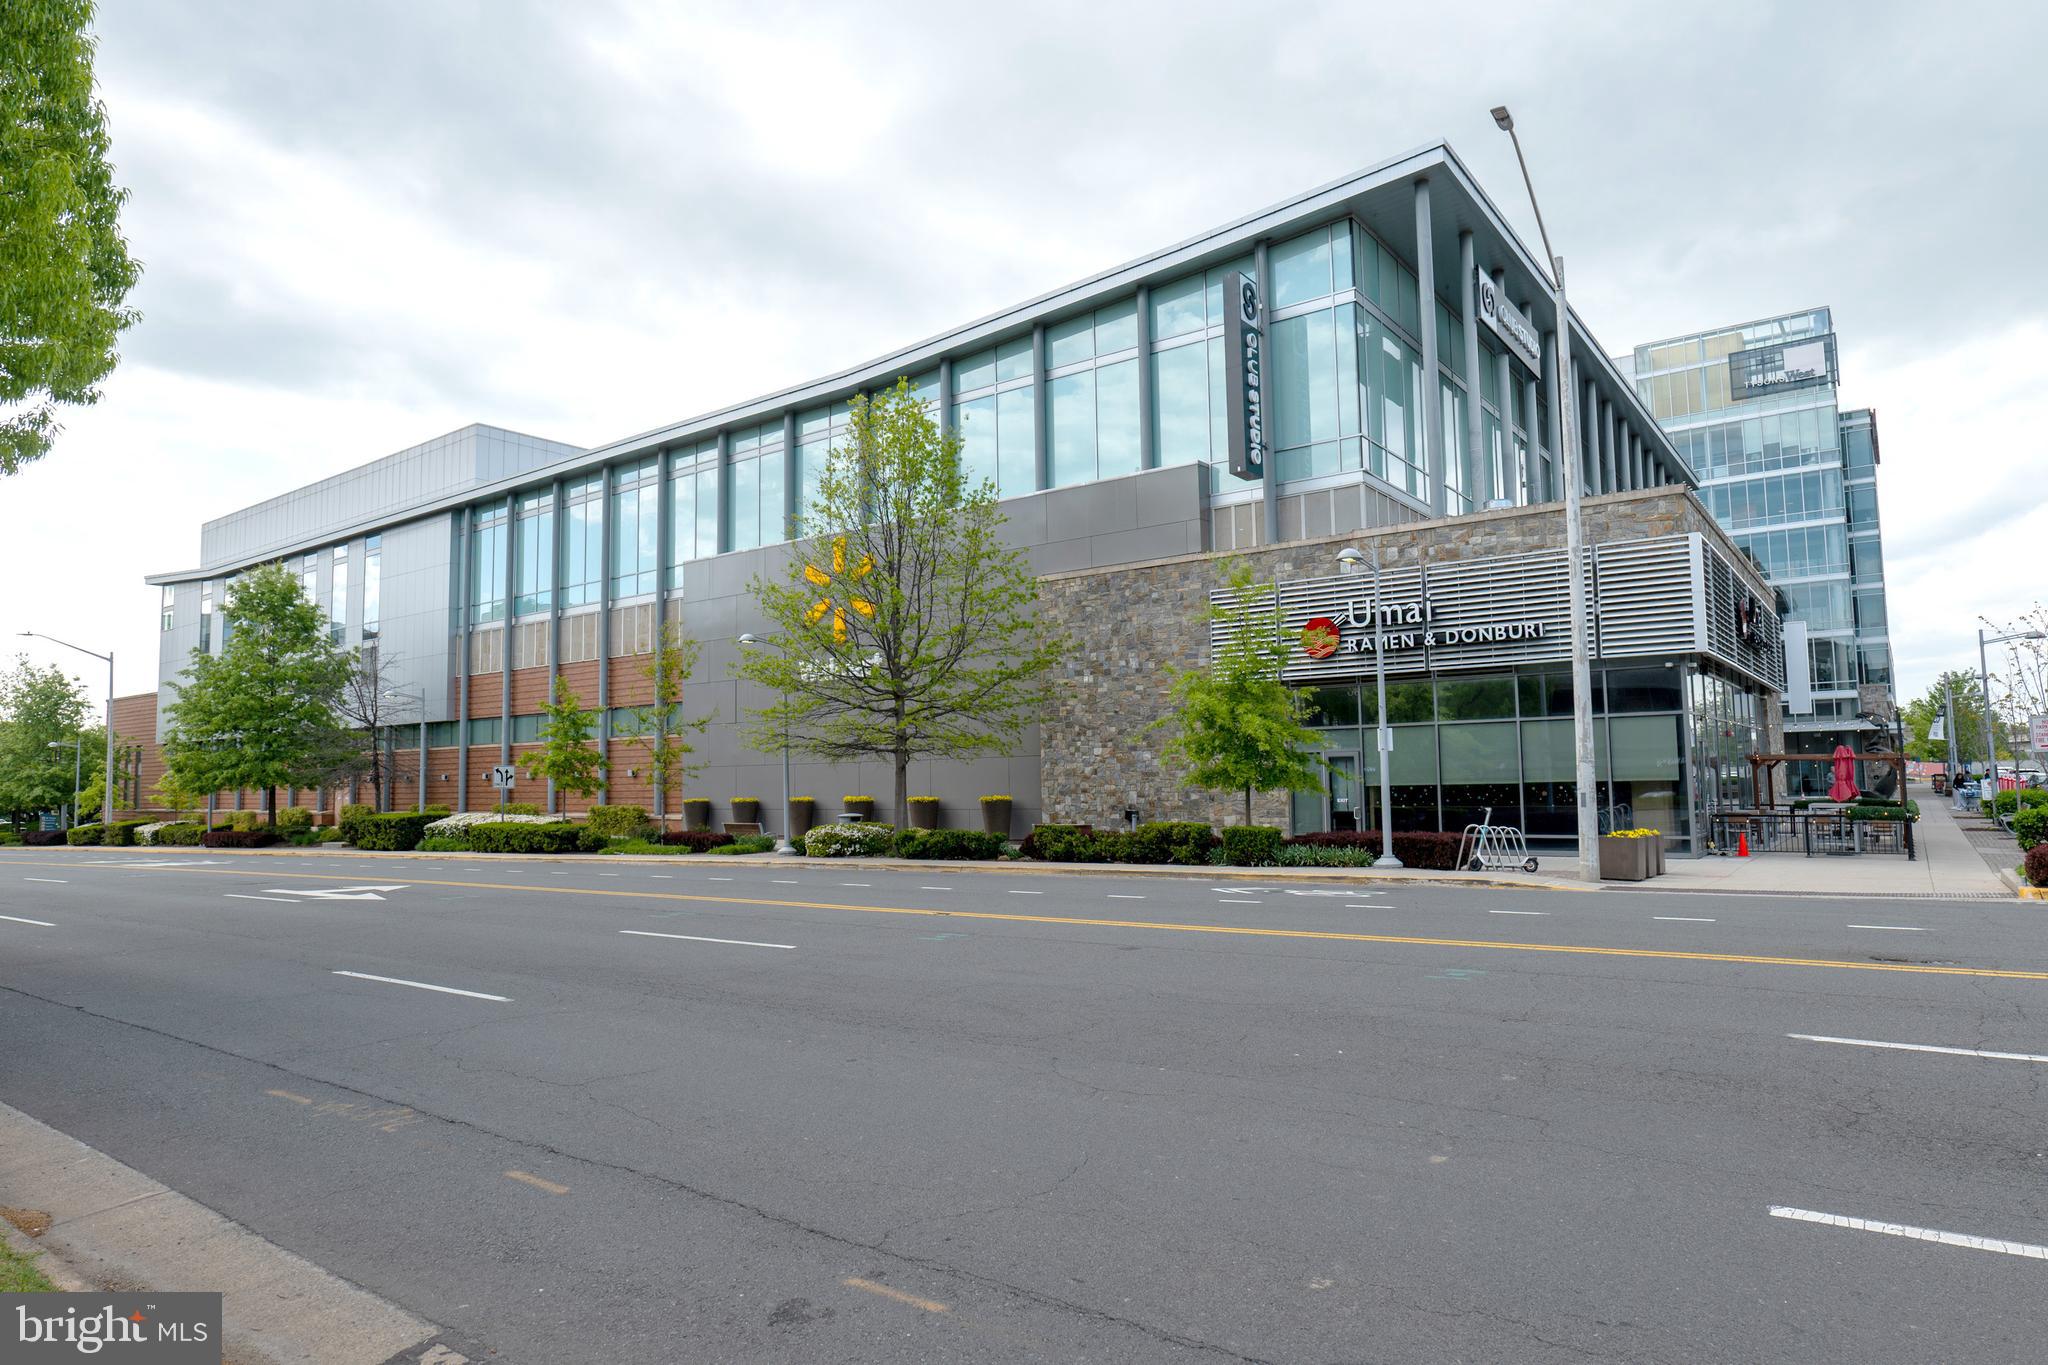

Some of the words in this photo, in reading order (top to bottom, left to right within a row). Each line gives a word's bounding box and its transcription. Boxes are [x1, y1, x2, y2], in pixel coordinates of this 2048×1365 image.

[1784, 368, 1815, 382] West
[1249, 389, 1261, 465] STUDIO
[1347, 593, 1432, 628] Umai
[1348, 633, 1416, 653] RAMEN
[1424, 631, 1437, 647] &
[1445, 622, 1545, 645] DONBURI
